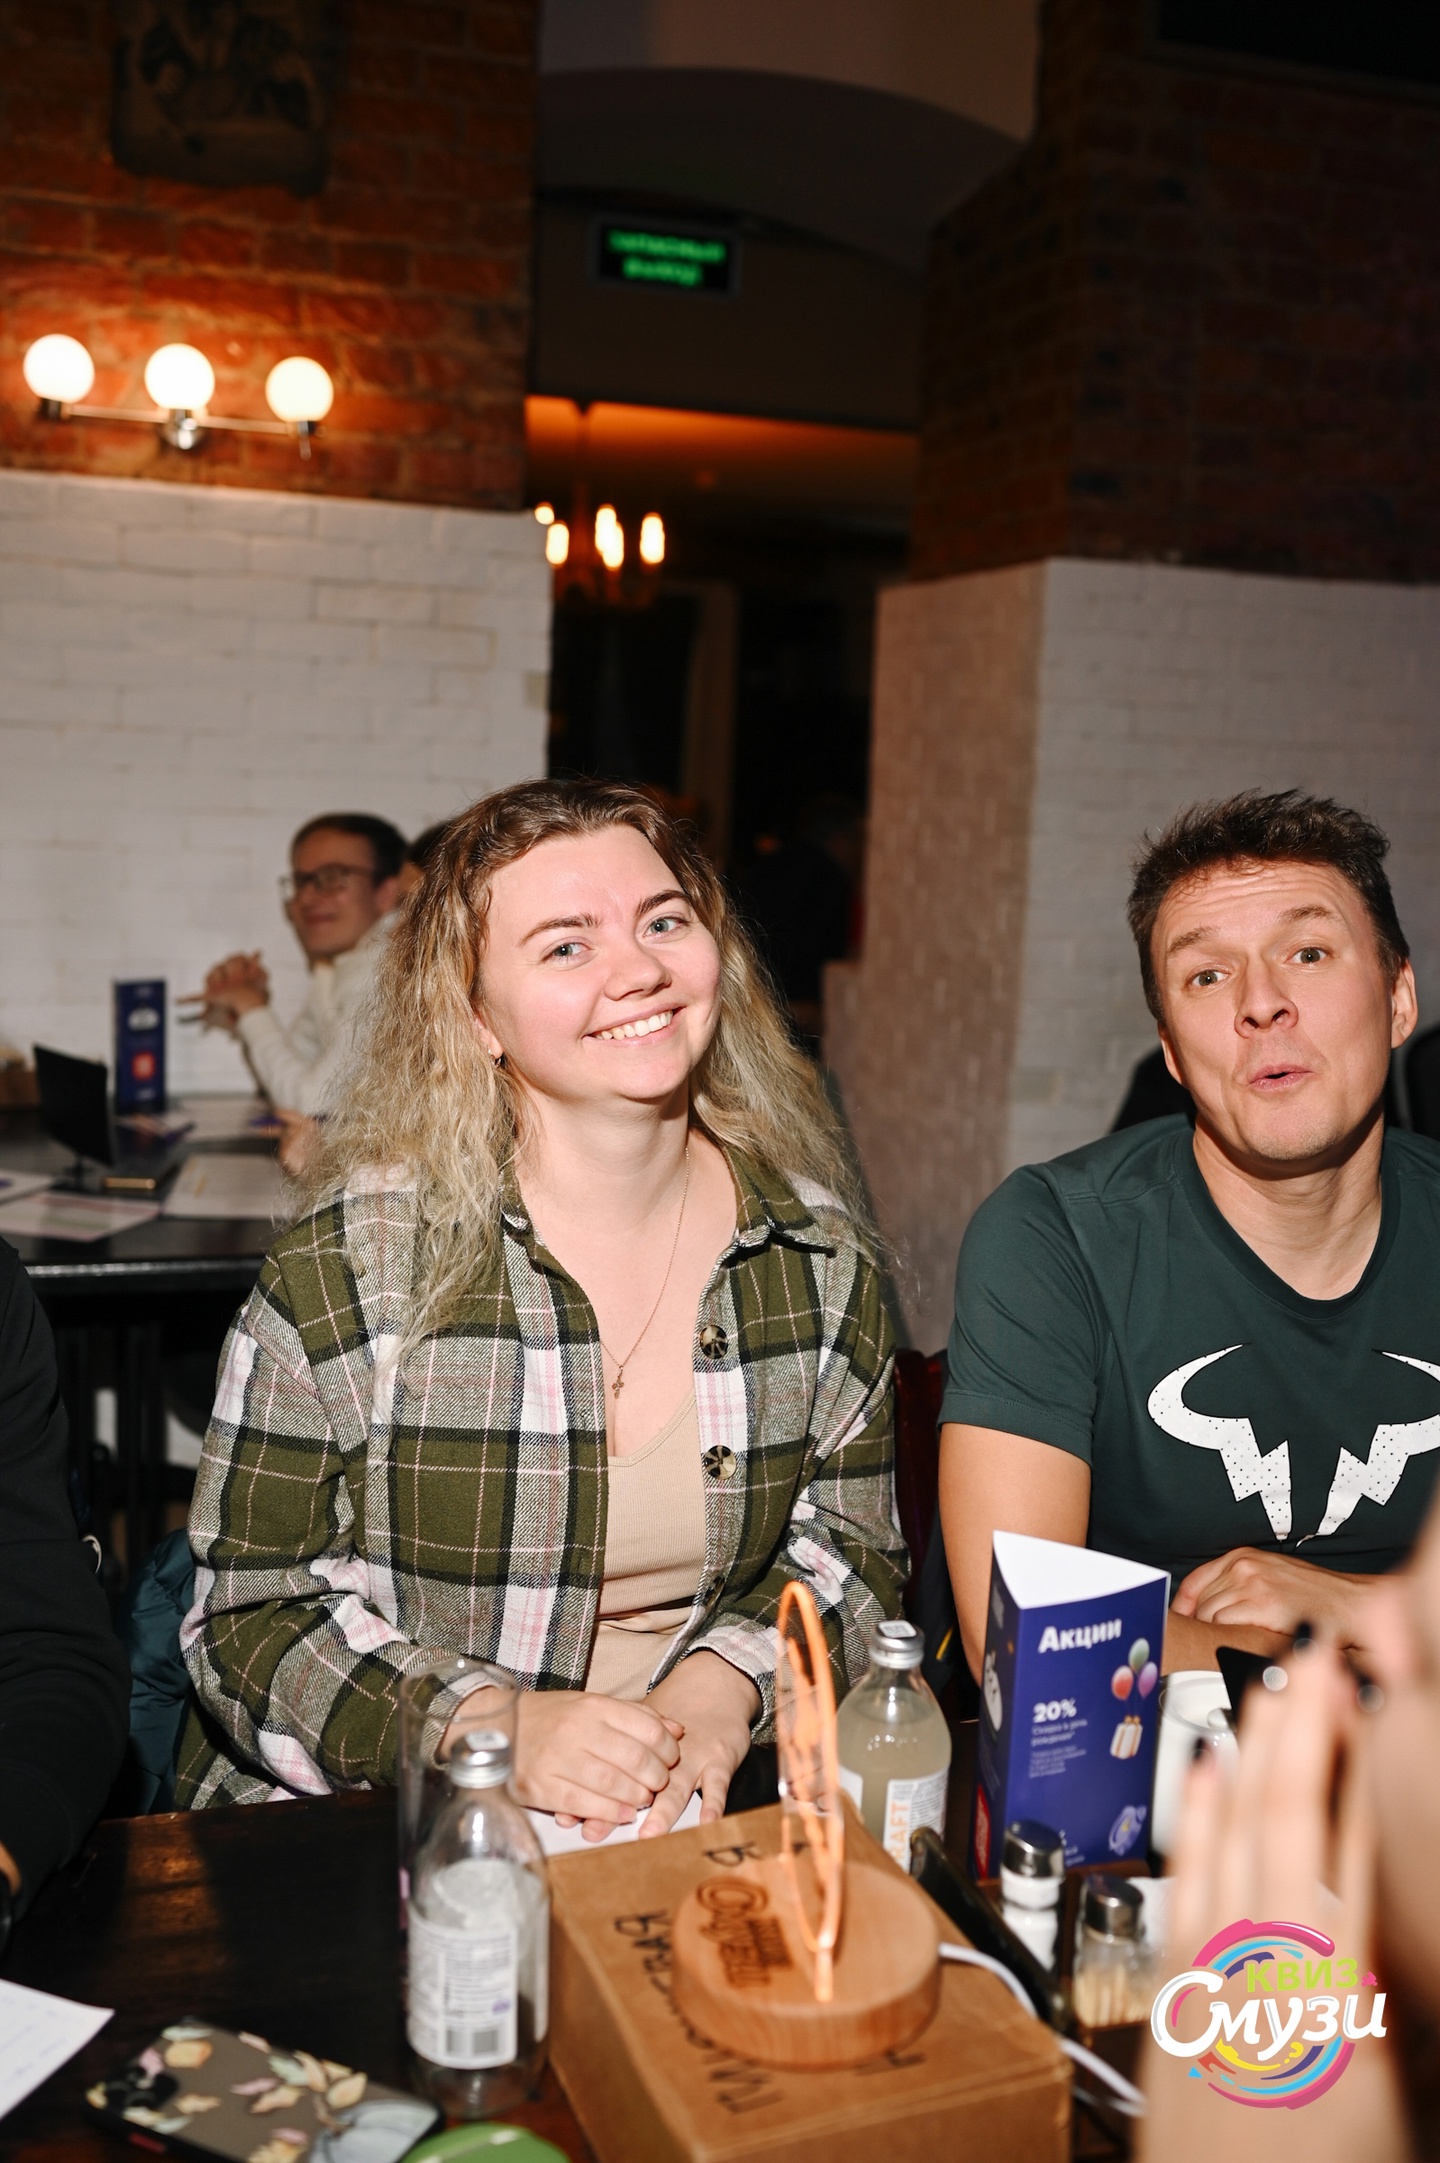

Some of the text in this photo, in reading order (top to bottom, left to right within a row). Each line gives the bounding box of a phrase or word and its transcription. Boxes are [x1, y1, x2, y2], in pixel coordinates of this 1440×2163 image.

[1038, 1619, 1122, 1653] Акции
[1033, 1697, 1077, 1723] 20%
[889, 1801, 909, 1861] RAFT
